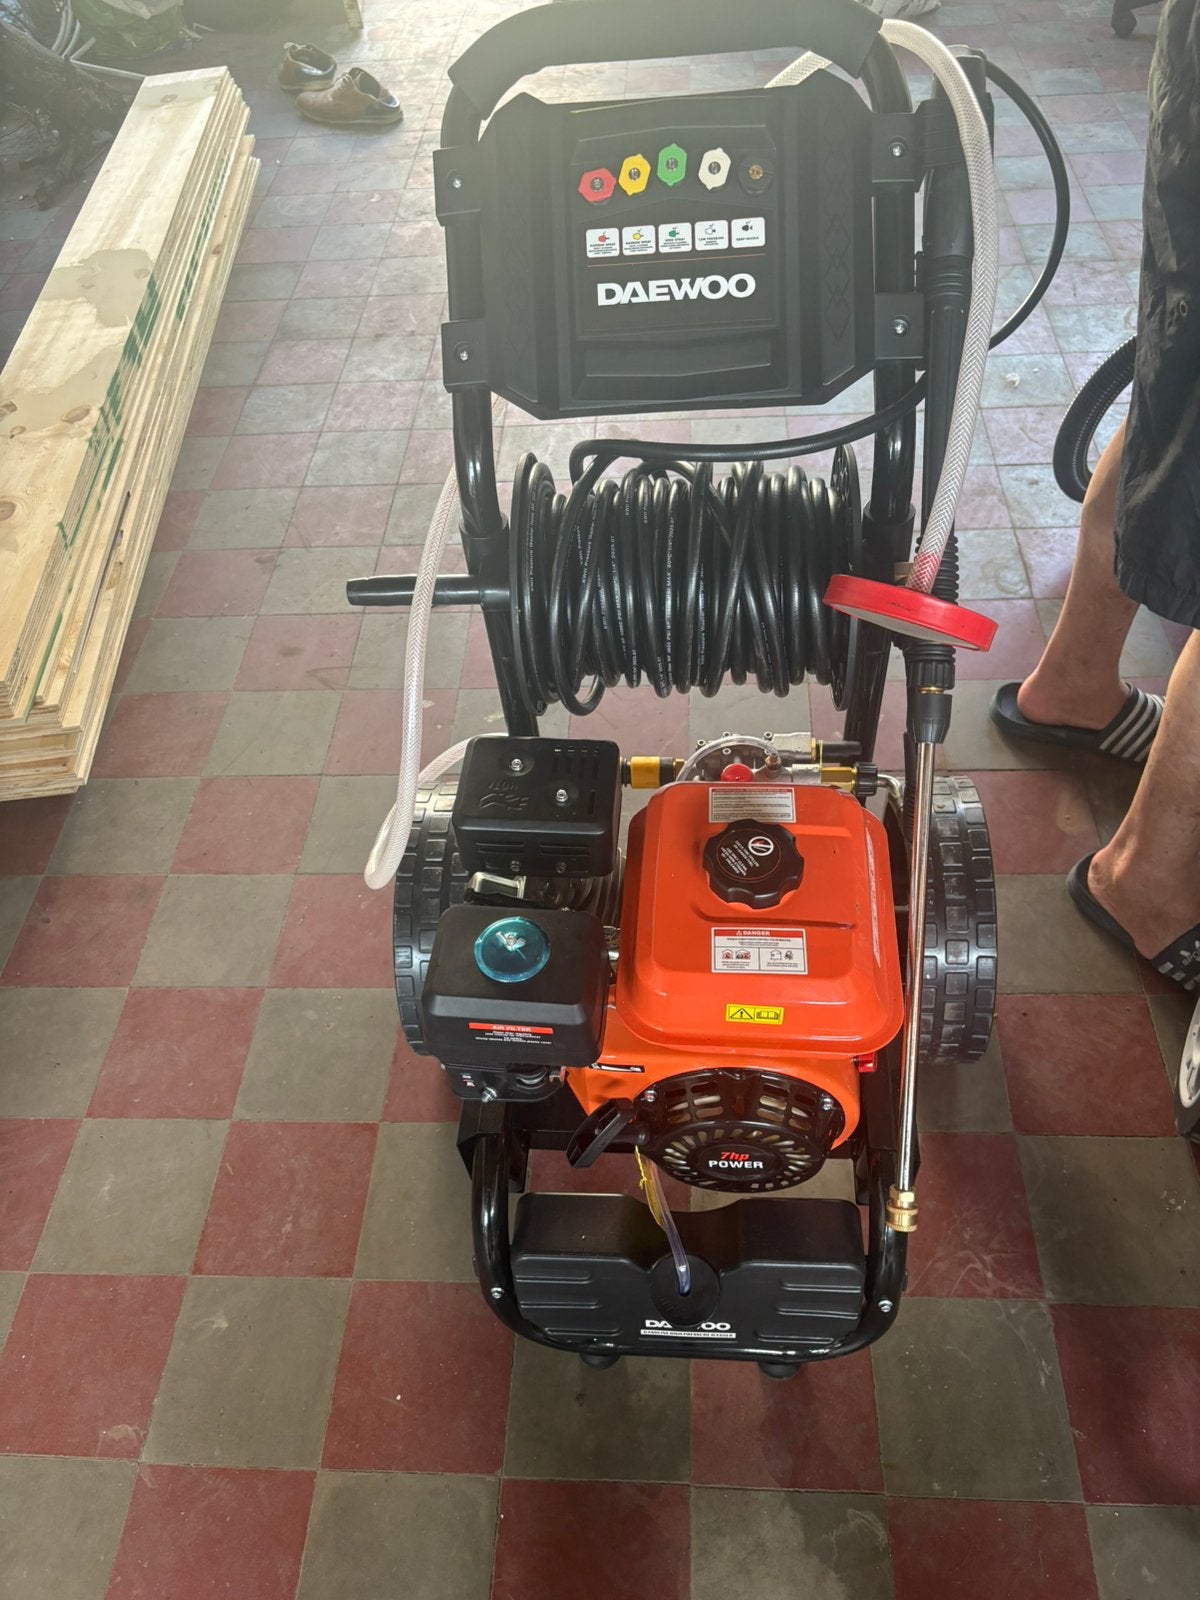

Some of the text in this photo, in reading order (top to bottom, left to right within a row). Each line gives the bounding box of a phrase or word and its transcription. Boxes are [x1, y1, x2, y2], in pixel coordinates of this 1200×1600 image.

[597, 273, 756, 306] DAEWOO
[720, 1151, 750, 1162] 7hp
[708, 1160, 764, 1168] POWER
[645, 1320, 731, 1330] DAOO
